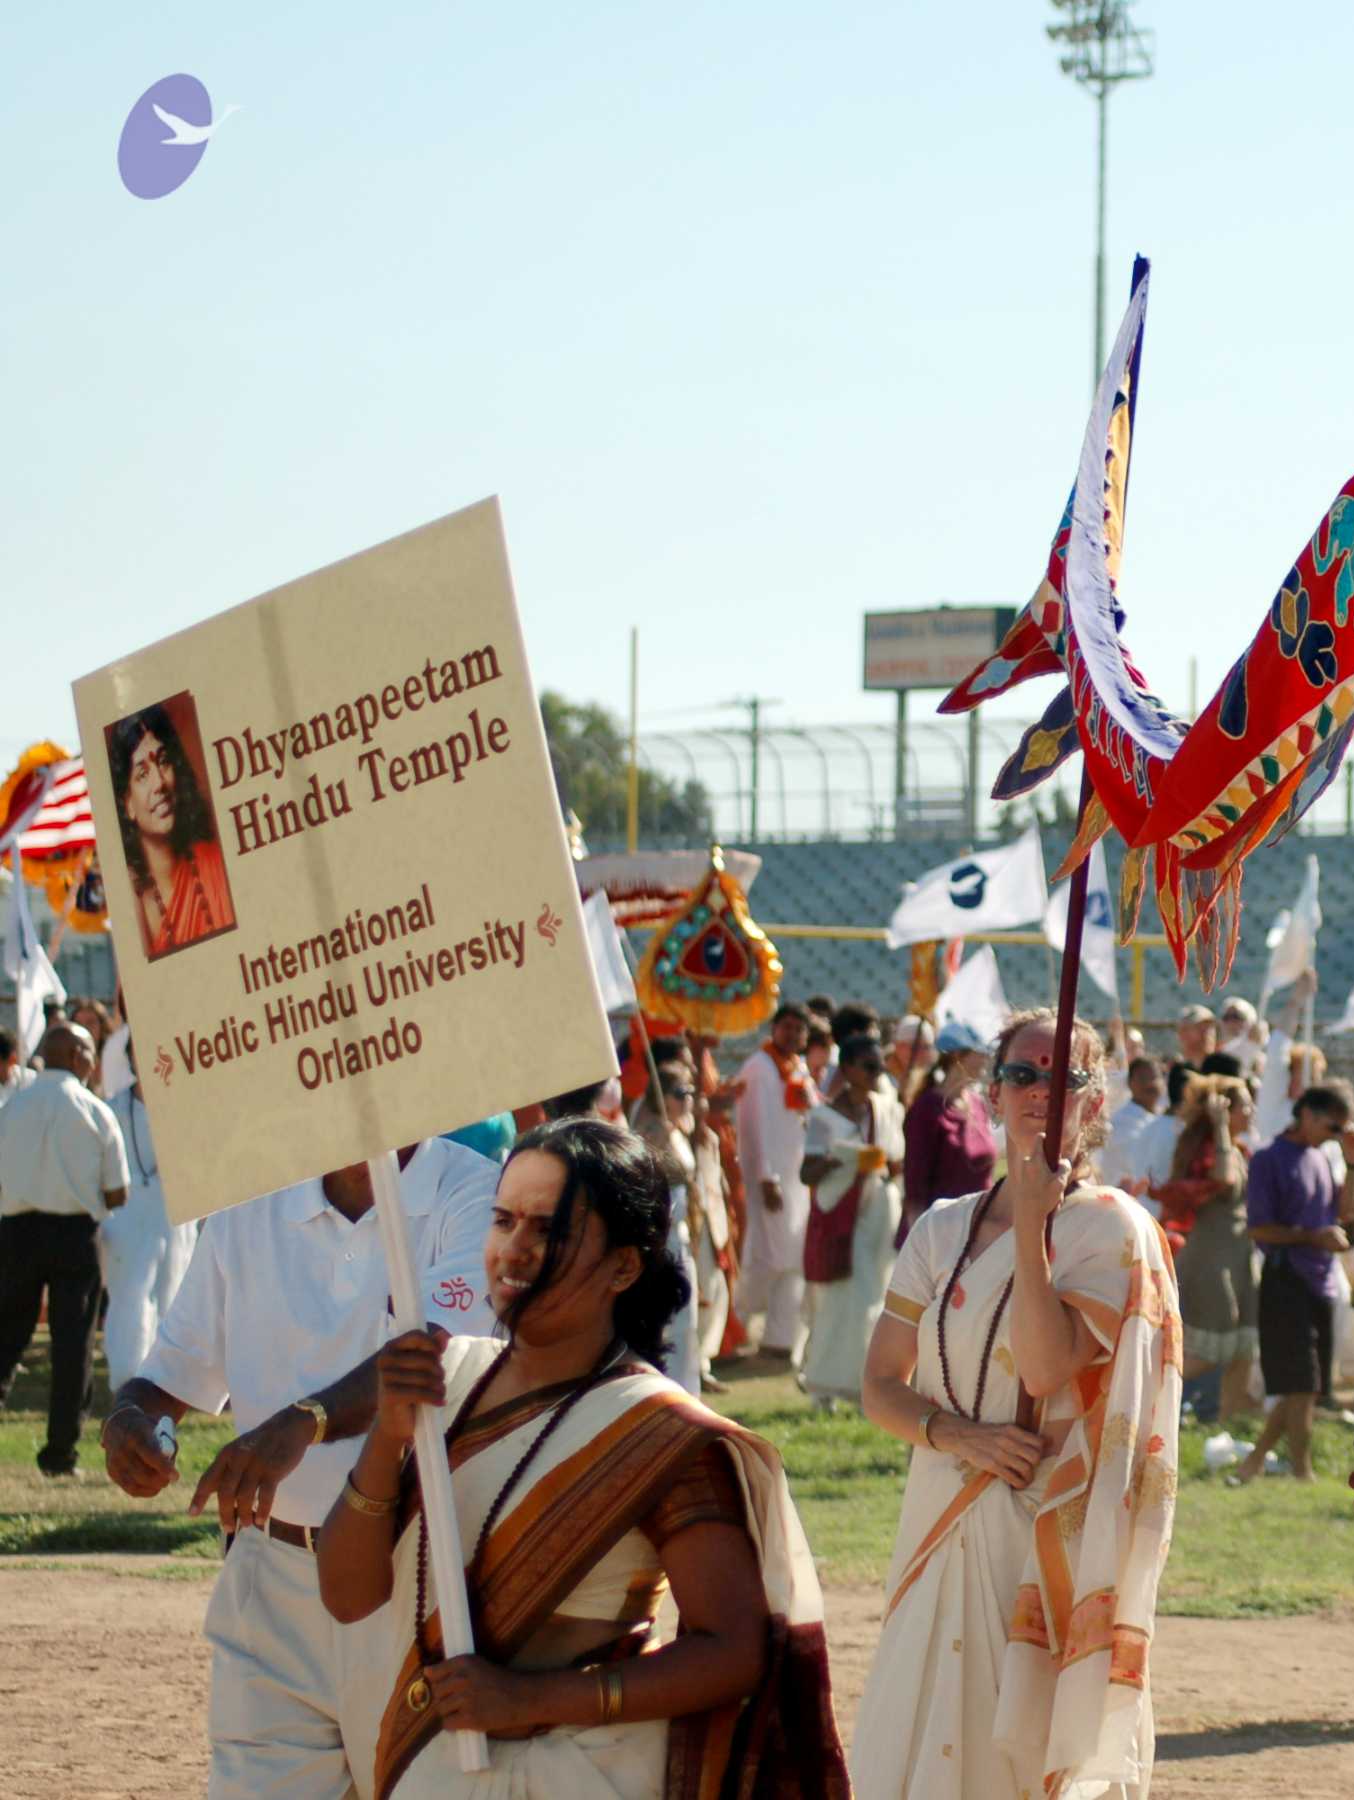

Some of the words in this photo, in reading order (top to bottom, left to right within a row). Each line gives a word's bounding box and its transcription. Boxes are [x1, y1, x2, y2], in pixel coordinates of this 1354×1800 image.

[212, 644, 502, 789] Dhyanapeetam
[229, 774, 353, 856] Hindu
[358, 708, 511, 803] Temple
[175, 1021, 260, 1077] Vedic
[265, 981, 358, 1046] Hindu
[363, 919, 528, 1007] University
[238, 884, 437, 994] International
[297, 1017, 424, 1091] Orlando
